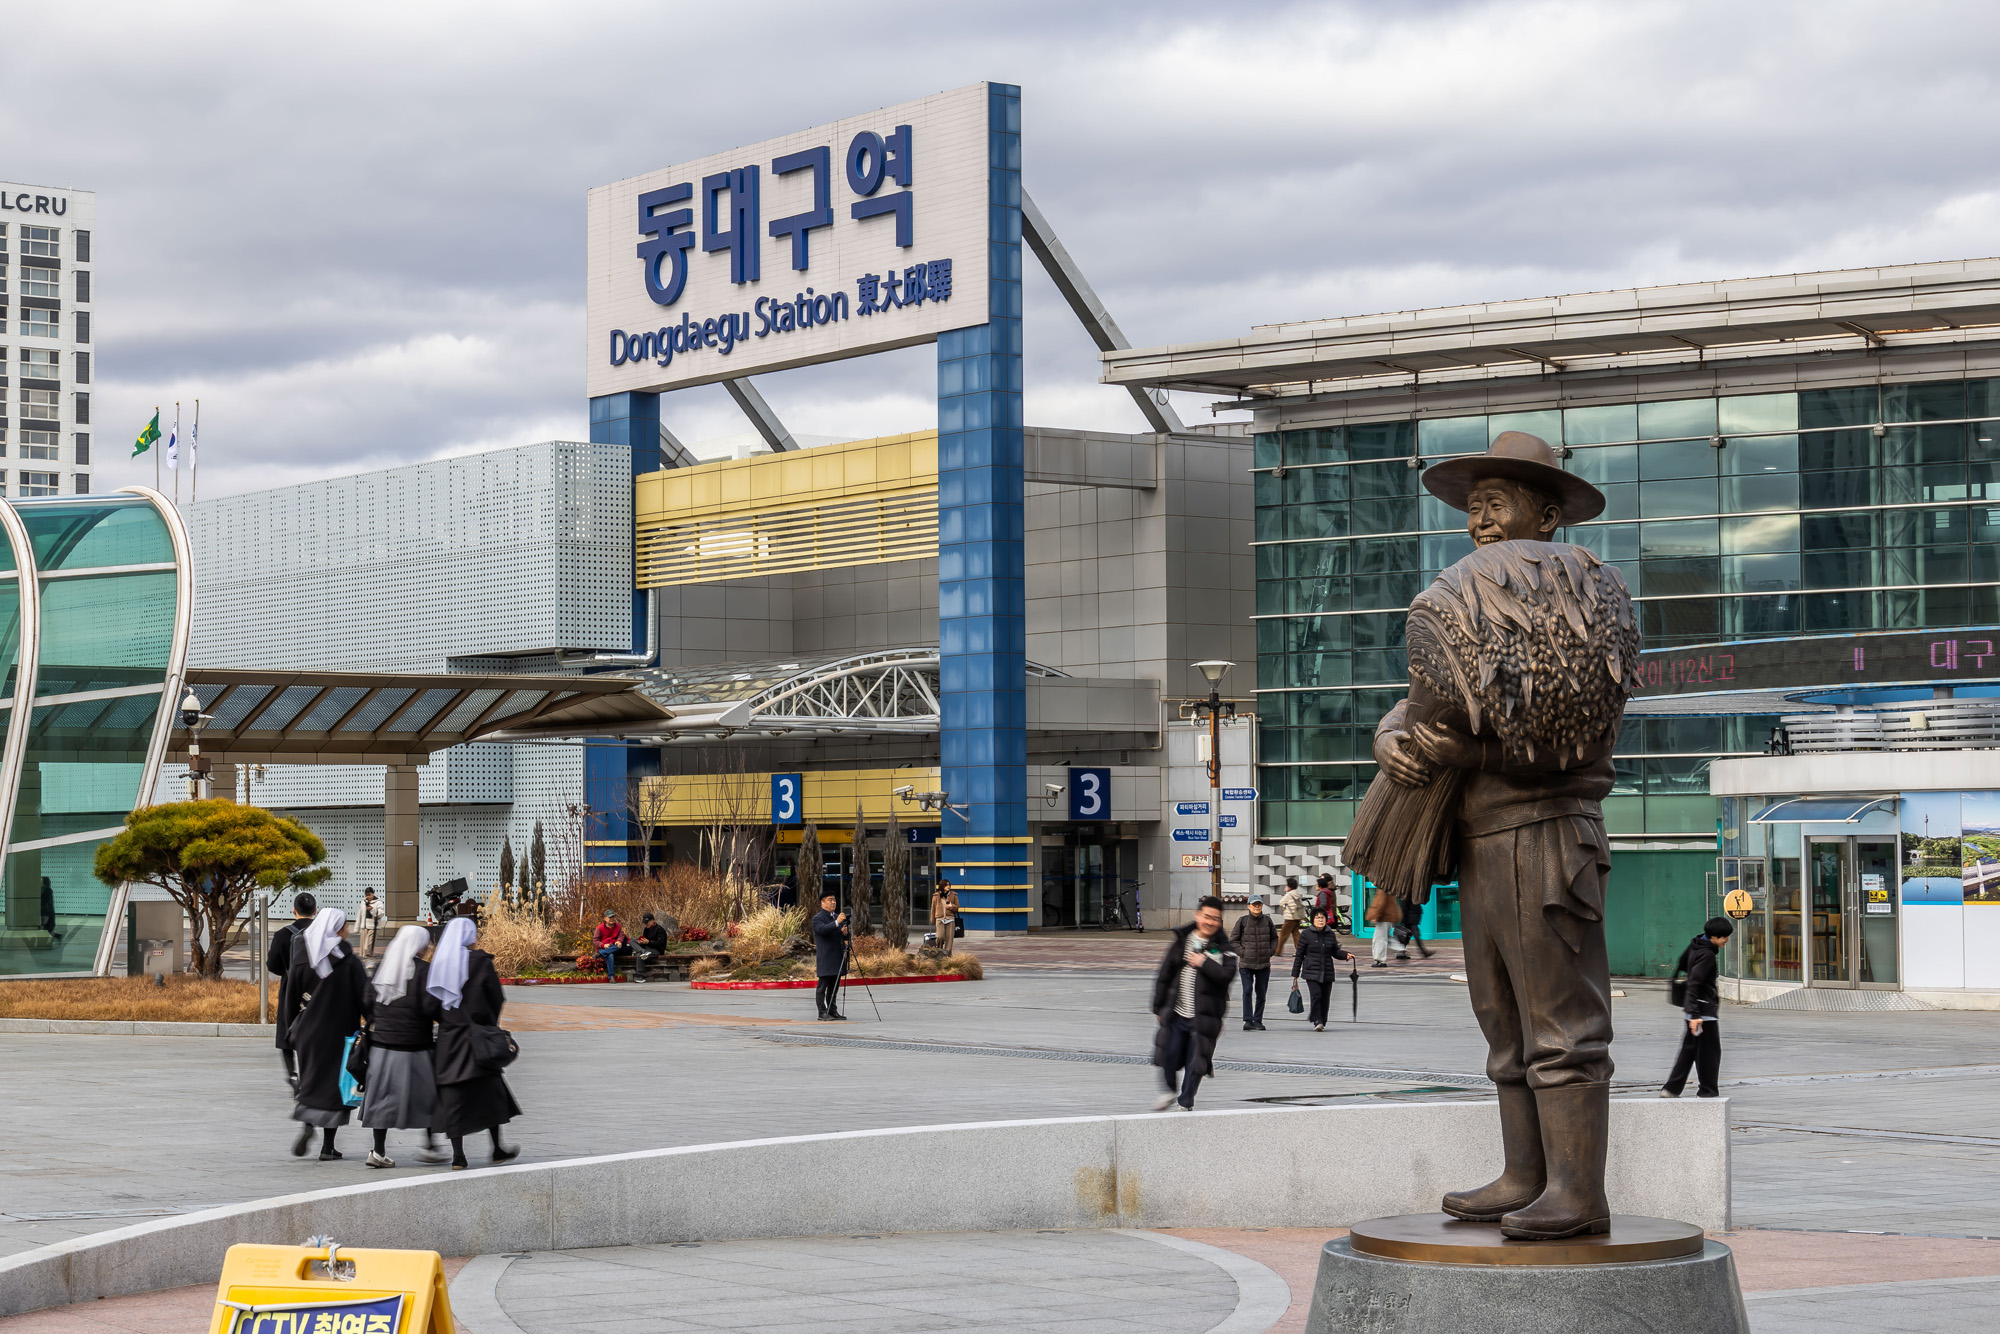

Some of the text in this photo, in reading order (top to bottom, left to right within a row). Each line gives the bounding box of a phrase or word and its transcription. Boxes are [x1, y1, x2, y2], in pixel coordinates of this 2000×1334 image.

[637, 124, 914, 306] 동대구역
[856, 258, 953, 316] 東大邱驛
[610, 287, 850, 367] Dongdaegu Station
[1671, 655, 1737, 684] 112신고
[1930, 640, 1996, 669] 대구
[778, 778, 795, 819] 3
[1080, 773, 1102, 815] 3
[781, 832, 785, 842] 3
[912, 829, 918, 841] 3
